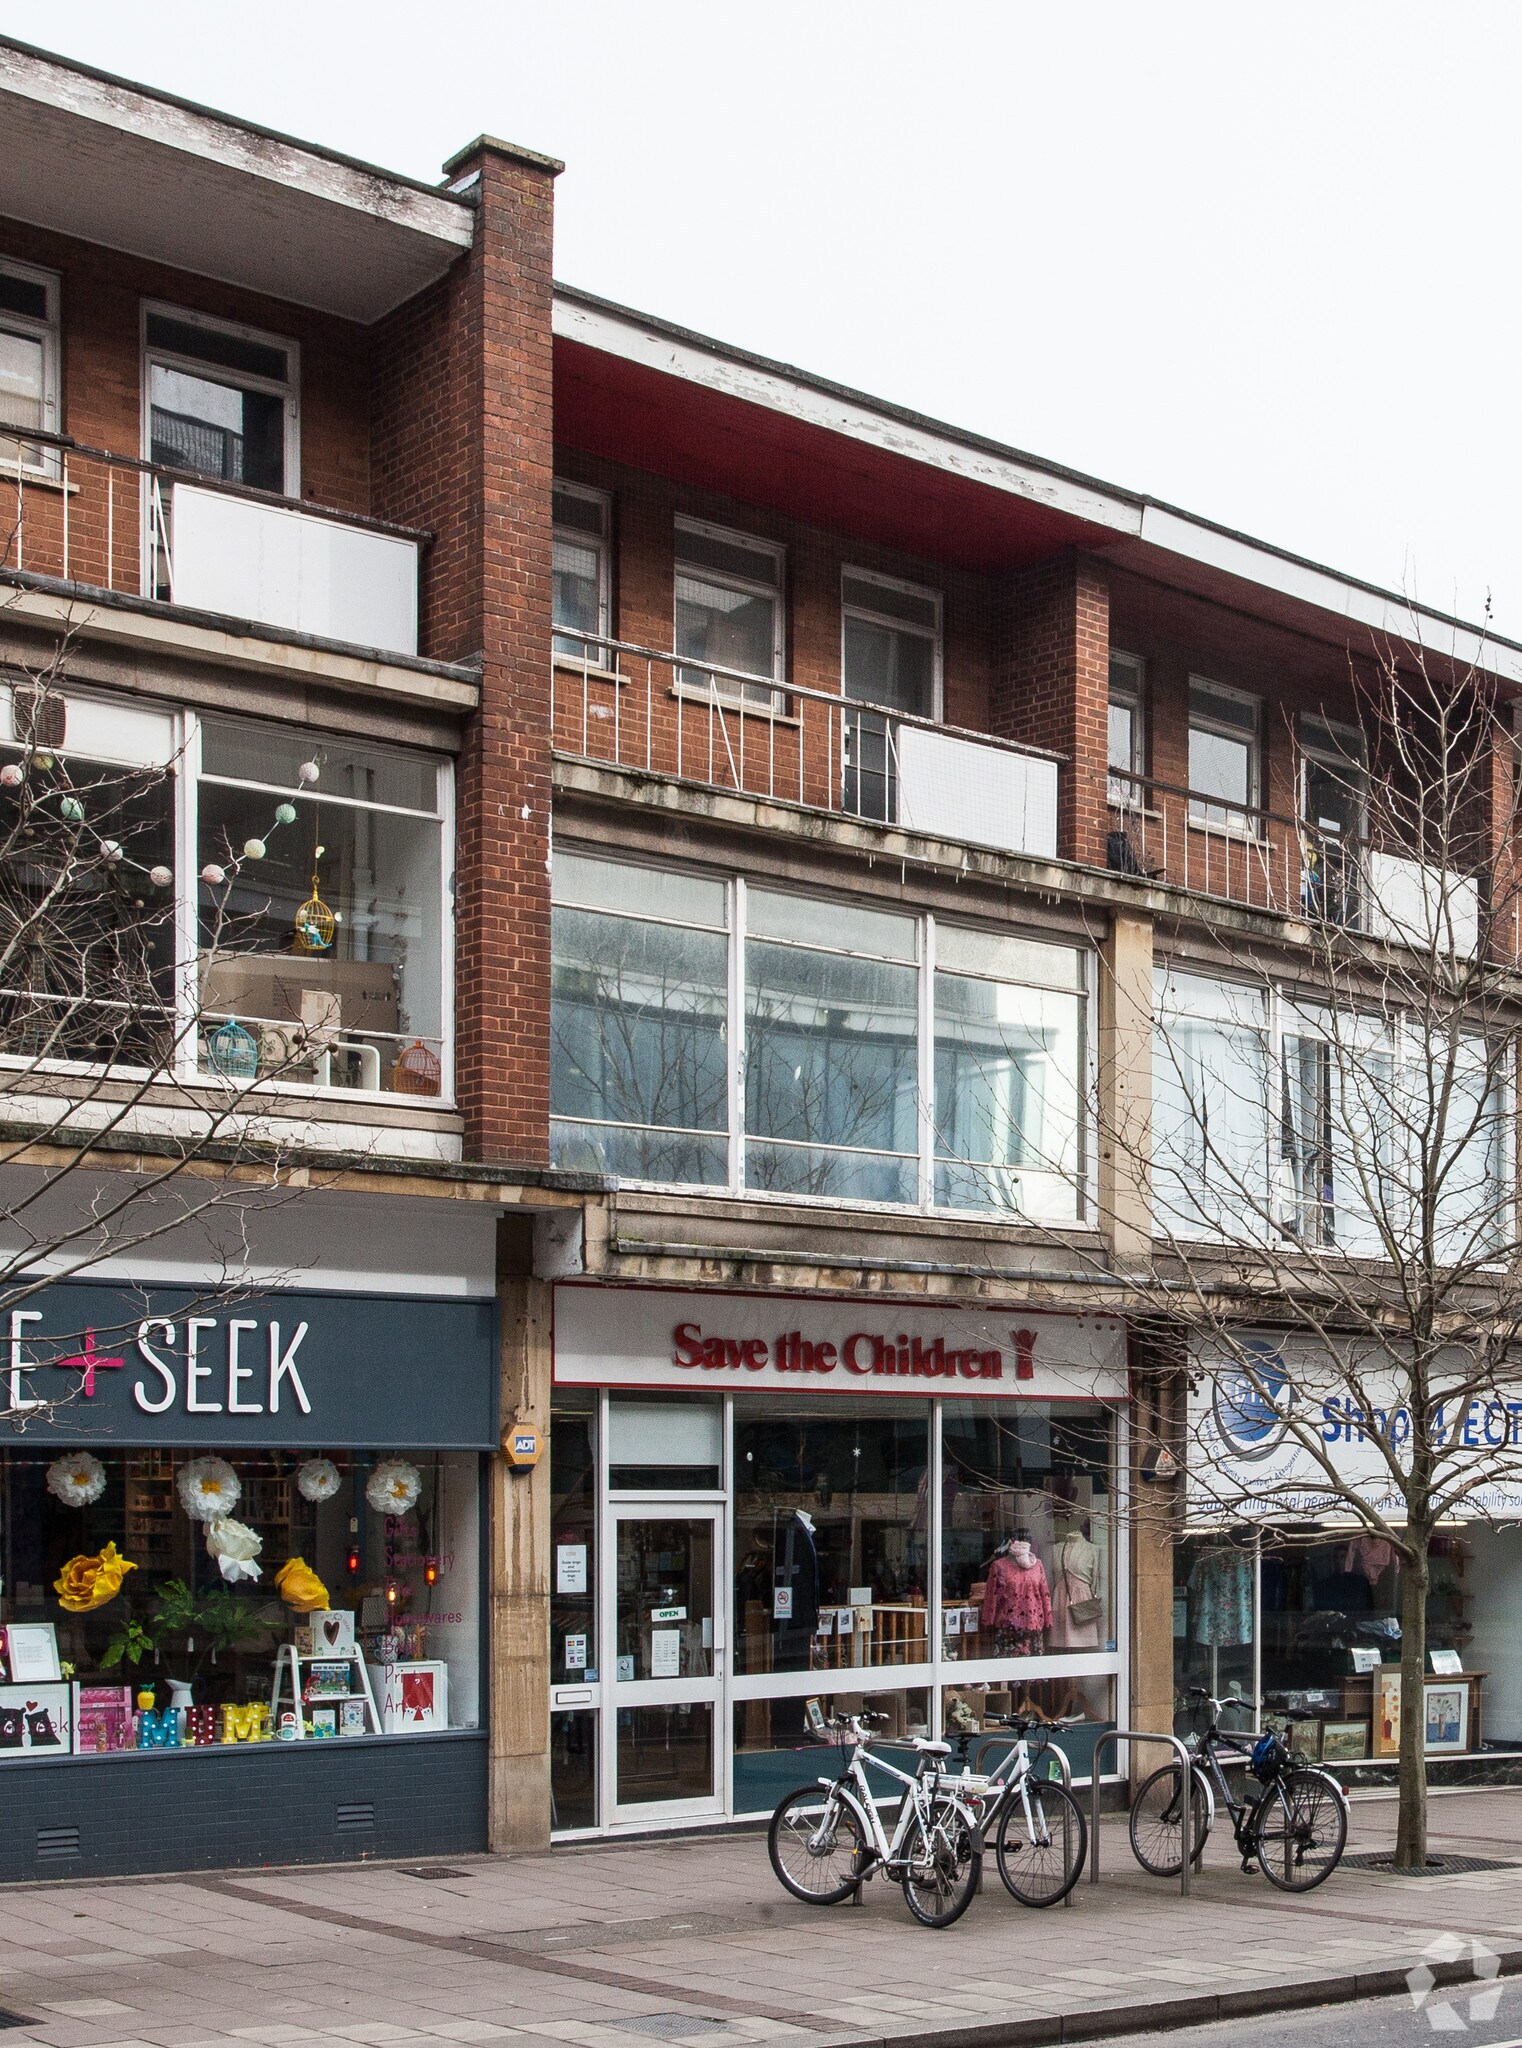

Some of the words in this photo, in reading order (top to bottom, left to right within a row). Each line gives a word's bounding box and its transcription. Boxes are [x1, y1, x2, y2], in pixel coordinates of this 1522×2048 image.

[134, 1318, 312, 1413] SEEK
[673, 1322, 769, 1370] Save
[773, 1330, 838, 1373] the
[843, 1332, 1004, 1379] Children
[1322, 1397, 1410, 1453] Shop
[515, 1439, 536, 1451] ADT
[1274, 1446, 1304, 1480] Associatio
[1463, 1492, 1506, 1513] mobility
[659, 1610, 679, 1618] OPEN
